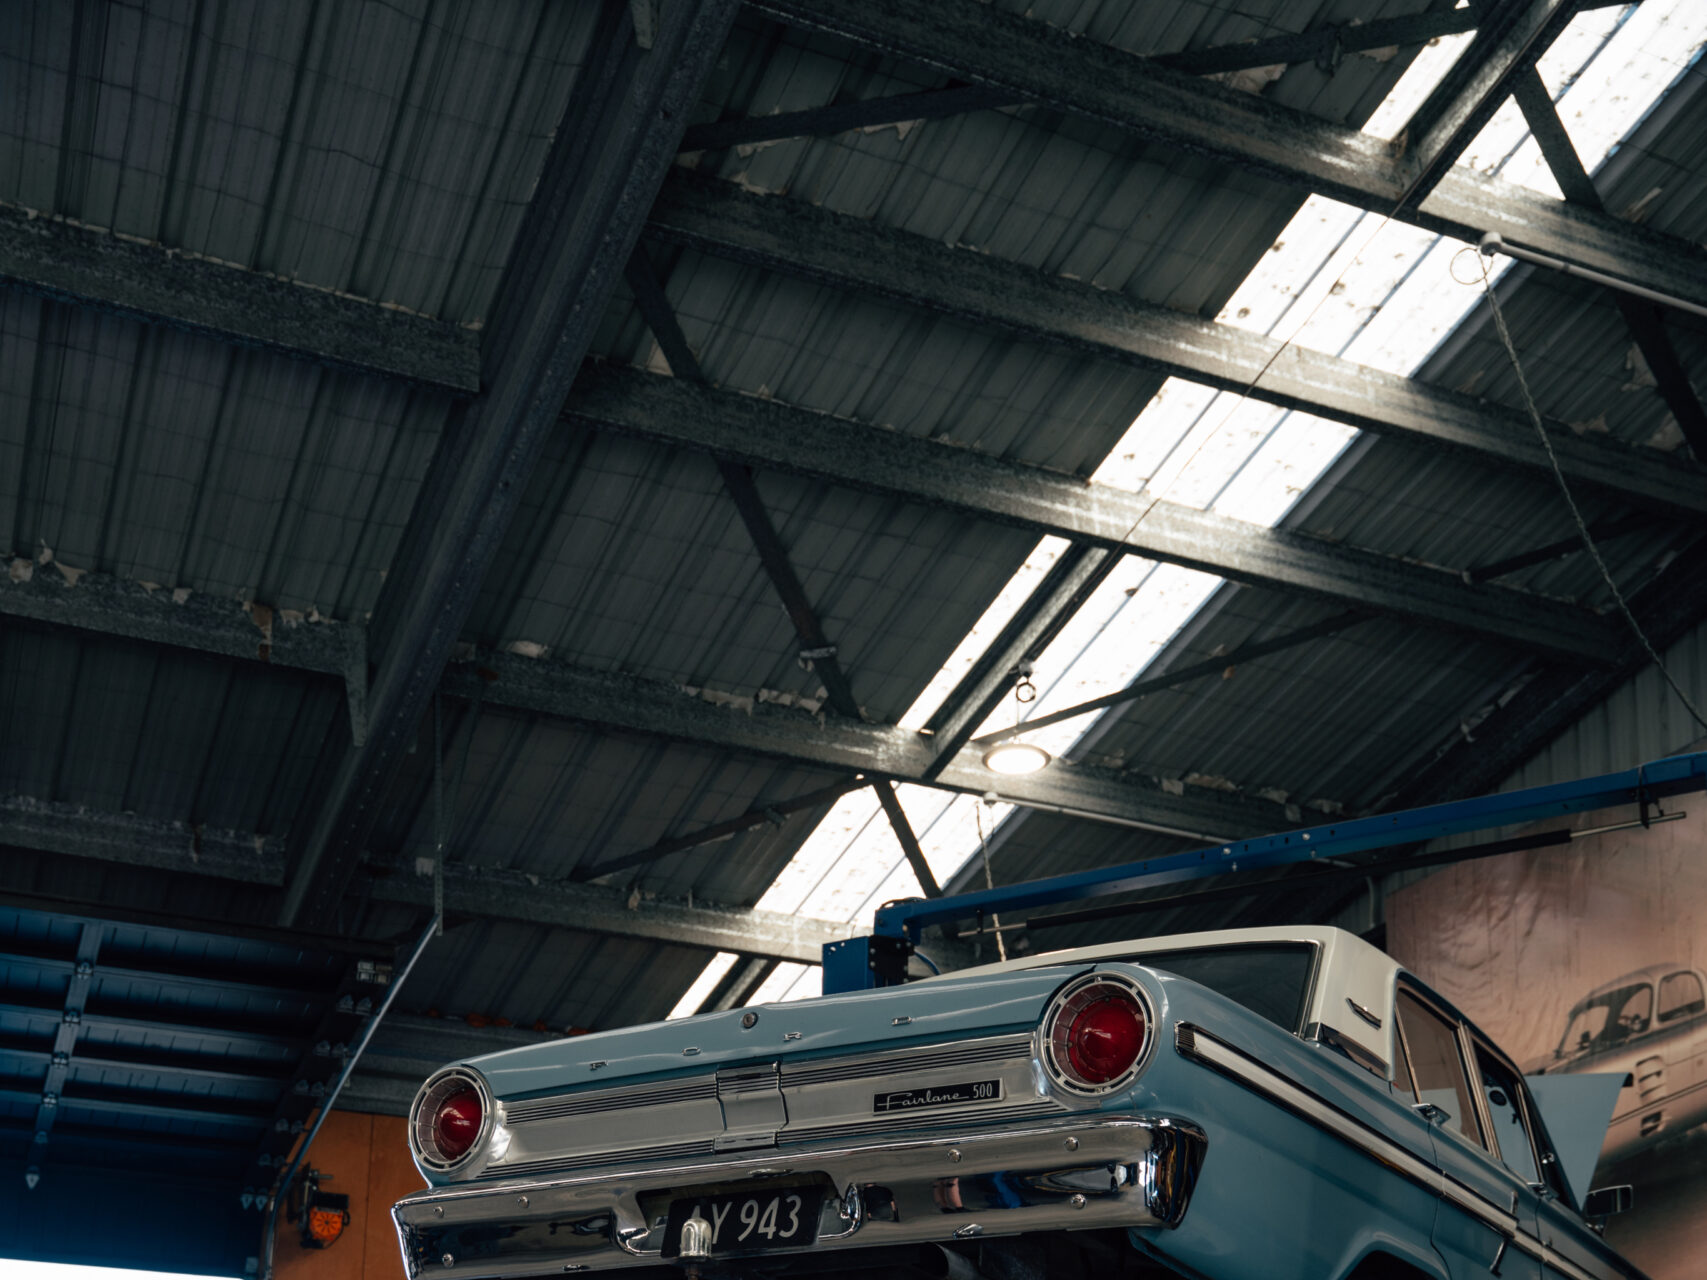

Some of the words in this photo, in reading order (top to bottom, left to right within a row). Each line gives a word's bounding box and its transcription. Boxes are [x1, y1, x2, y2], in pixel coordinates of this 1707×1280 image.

[876, 1089, 969, 1111] Fairlane
[973, 1083, 993, 1099] 500
[737, 1194, 802, 1242] 943
